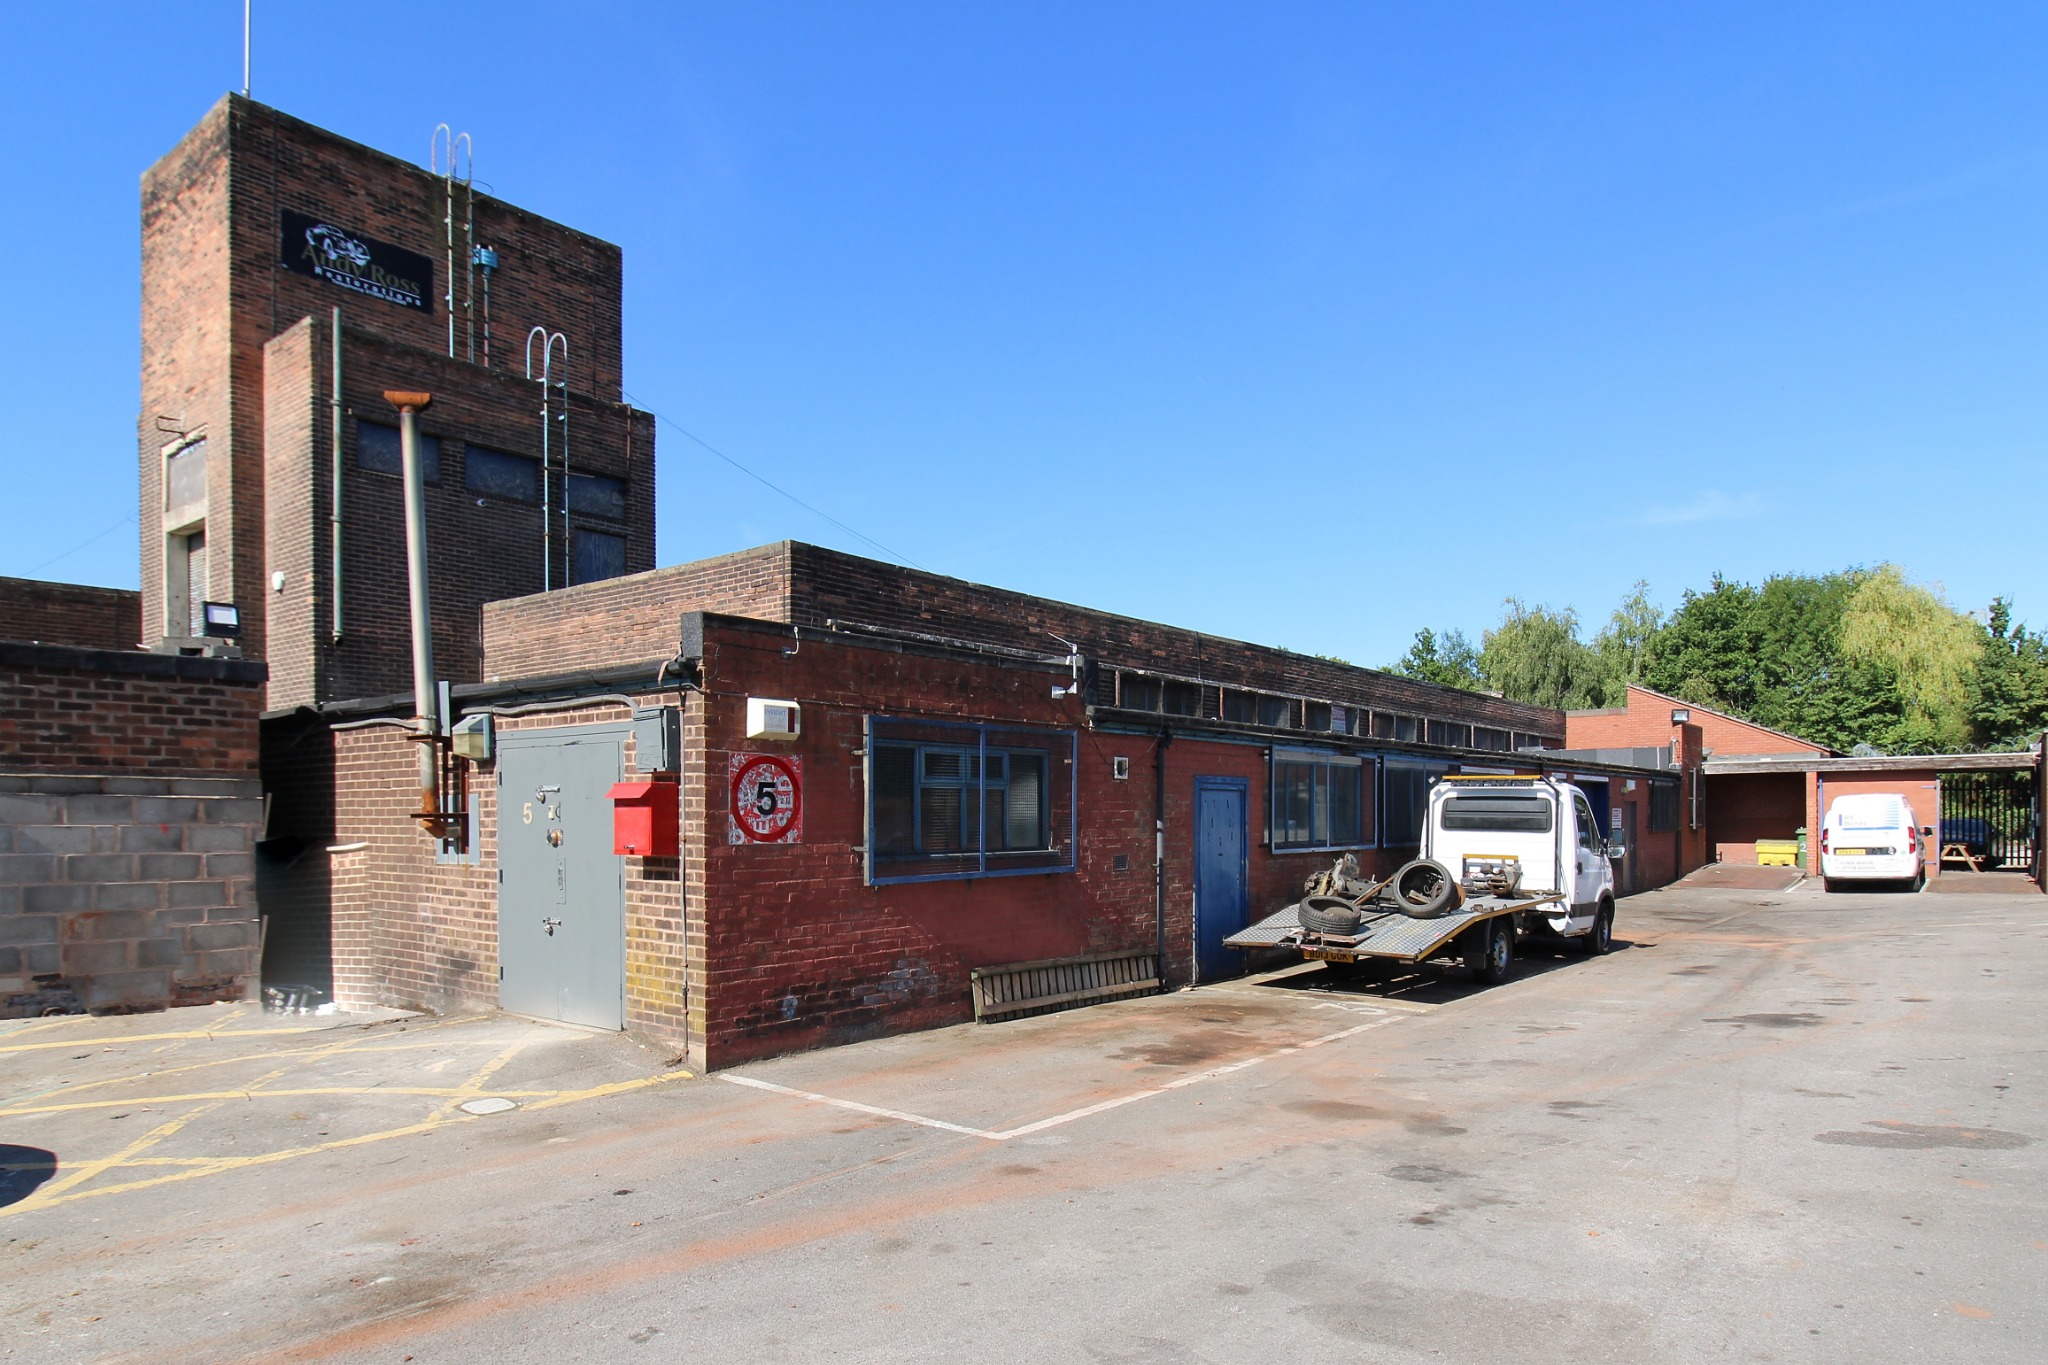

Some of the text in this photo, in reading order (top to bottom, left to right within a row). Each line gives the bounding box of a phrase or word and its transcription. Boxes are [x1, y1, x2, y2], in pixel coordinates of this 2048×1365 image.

[301, 244, 365, 279] Andy
[370, 264, 421, 294] Ross
[756, 782, 777, 816] 5
[523, 802, 533, 825] 5
[1800, 843, 1807, 852] 2
